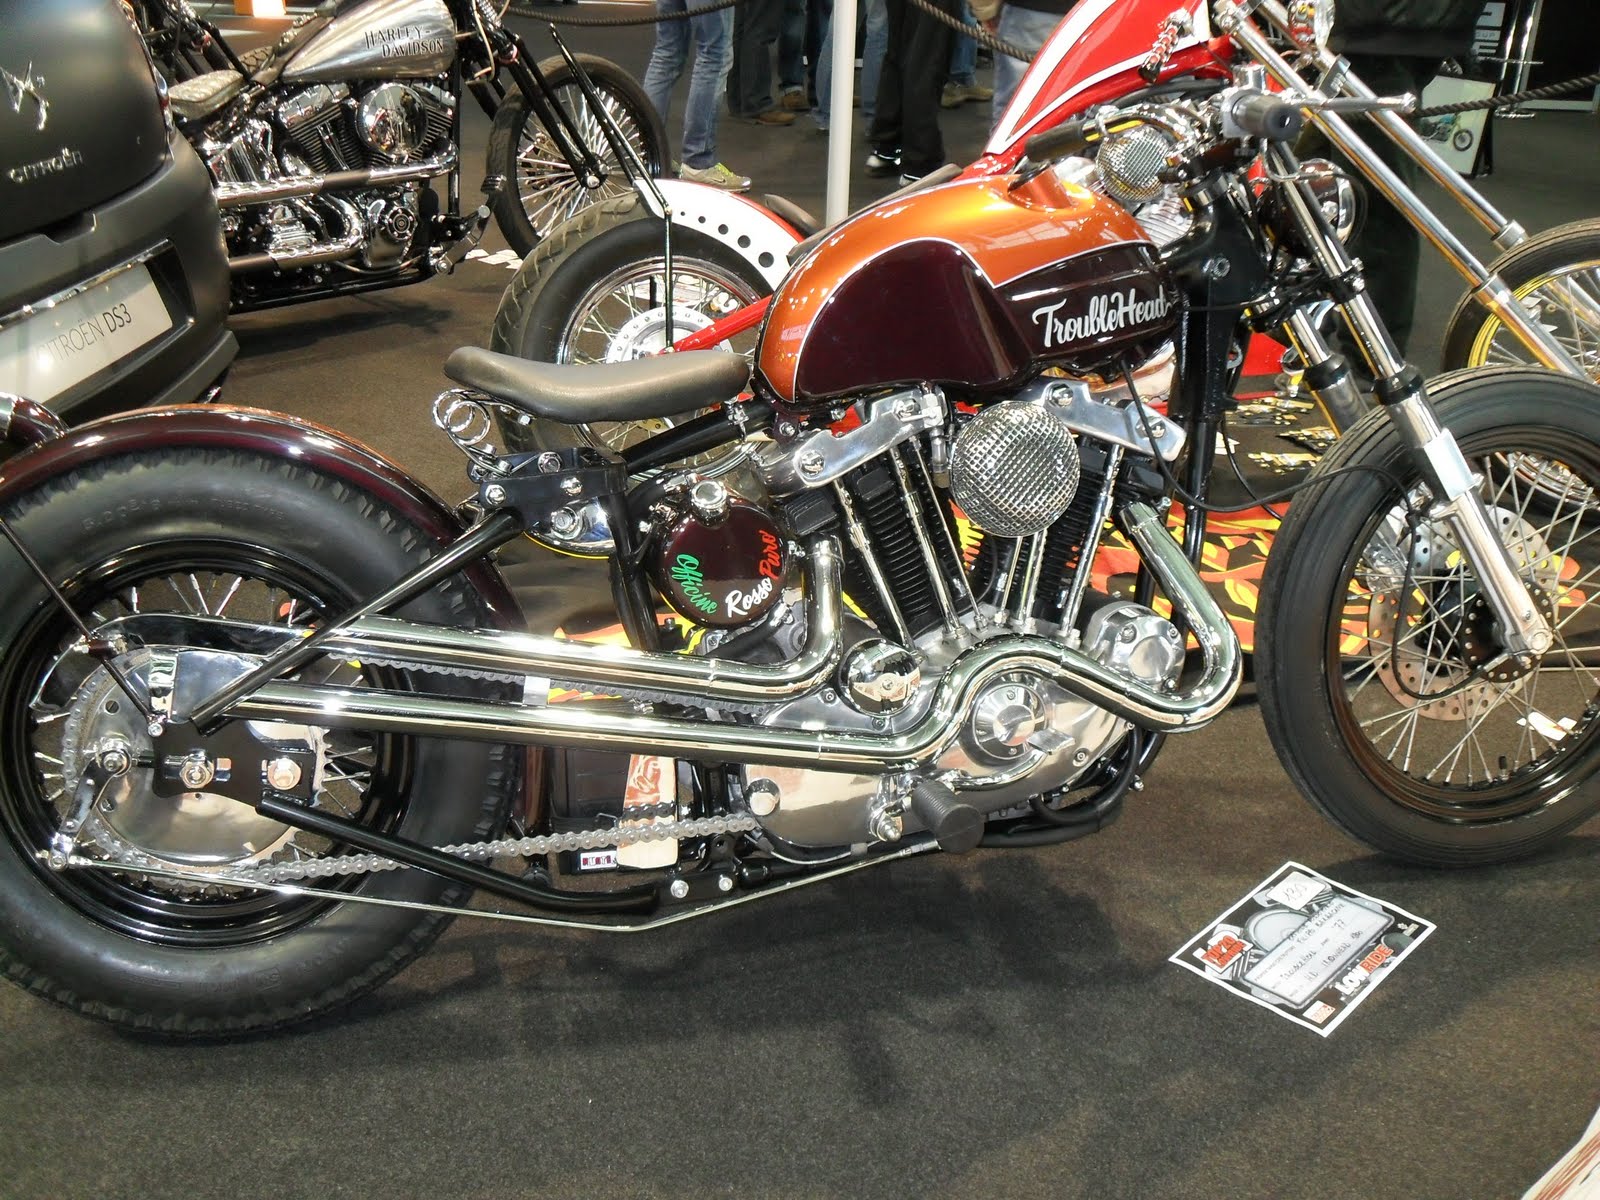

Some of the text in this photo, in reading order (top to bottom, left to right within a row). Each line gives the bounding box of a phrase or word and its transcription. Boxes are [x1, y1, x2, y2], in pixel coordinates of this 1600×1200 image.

[382, 38, 444, 58] DAVIDSON
[103, 303, 132, 333] DS3
[1032, 284, 1174, 348] TroubleHead
[671, 529, 781, 618] Officine Rosso Puro
